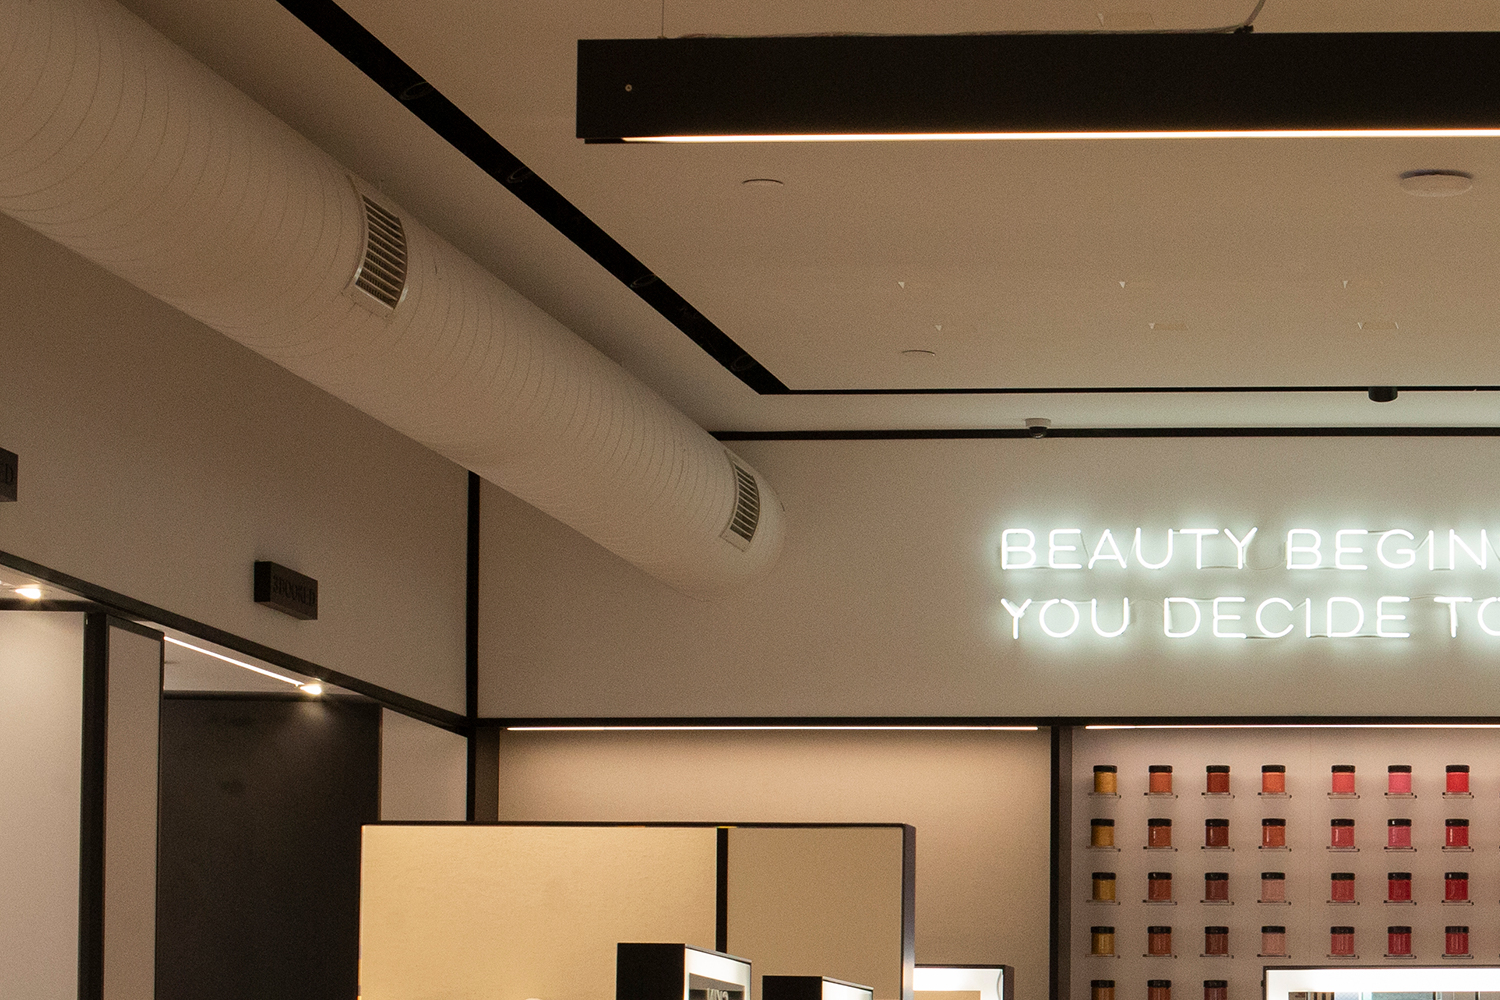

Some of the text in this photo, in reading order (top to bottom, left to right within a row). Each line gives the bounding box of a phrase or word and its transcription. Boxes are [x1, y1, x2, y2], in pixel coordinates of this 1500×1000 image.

[1001, 527, 1258, 570] BEAUTY
[1000, 597, 1129, 639] YOU
[1163, 596, 1410, 638] DECIDE
